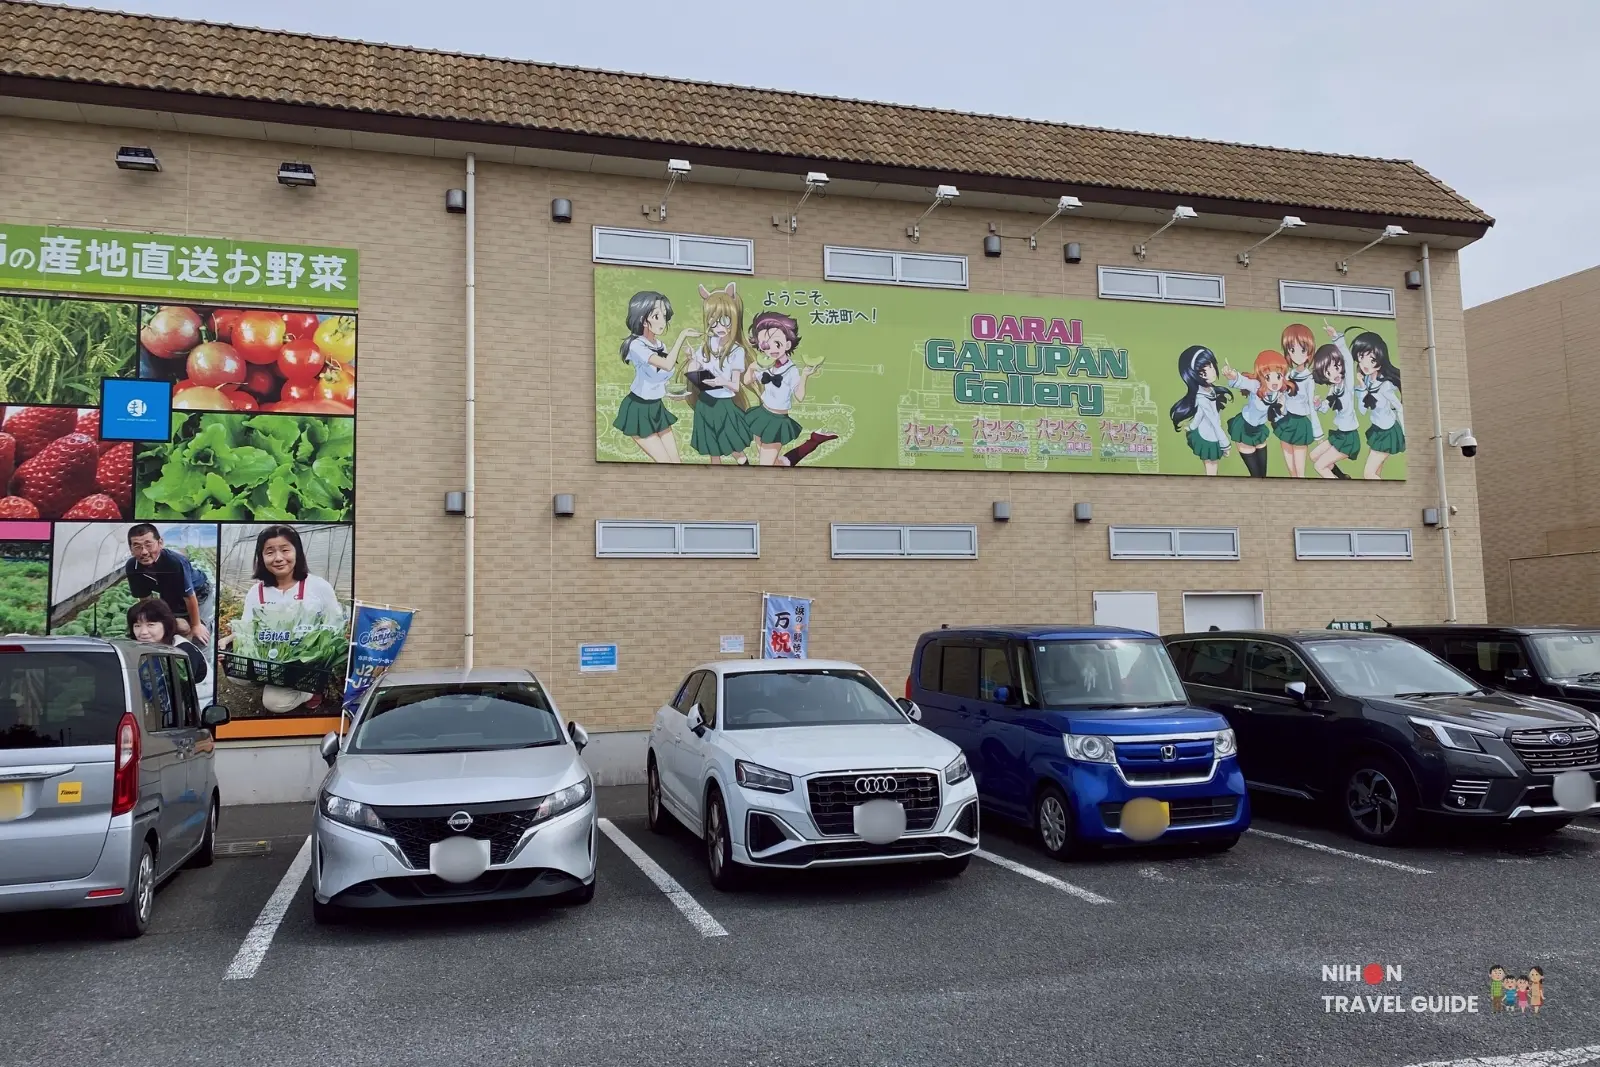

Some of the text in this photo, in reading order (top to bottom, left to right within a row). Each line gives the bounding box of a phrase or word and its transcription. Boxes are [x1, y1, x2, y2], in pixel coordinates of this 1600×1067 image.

[0, 233, 347, 292] の産地直送お野菜
[762, 290, 830, 306] ようこそ、
[971, 313, 1083, 345] OARAI
[925, 338, 1129, 380] GARUPAN
[953, 371, 1105, 416] Gallery
[356, 663, 374, 677] J2
